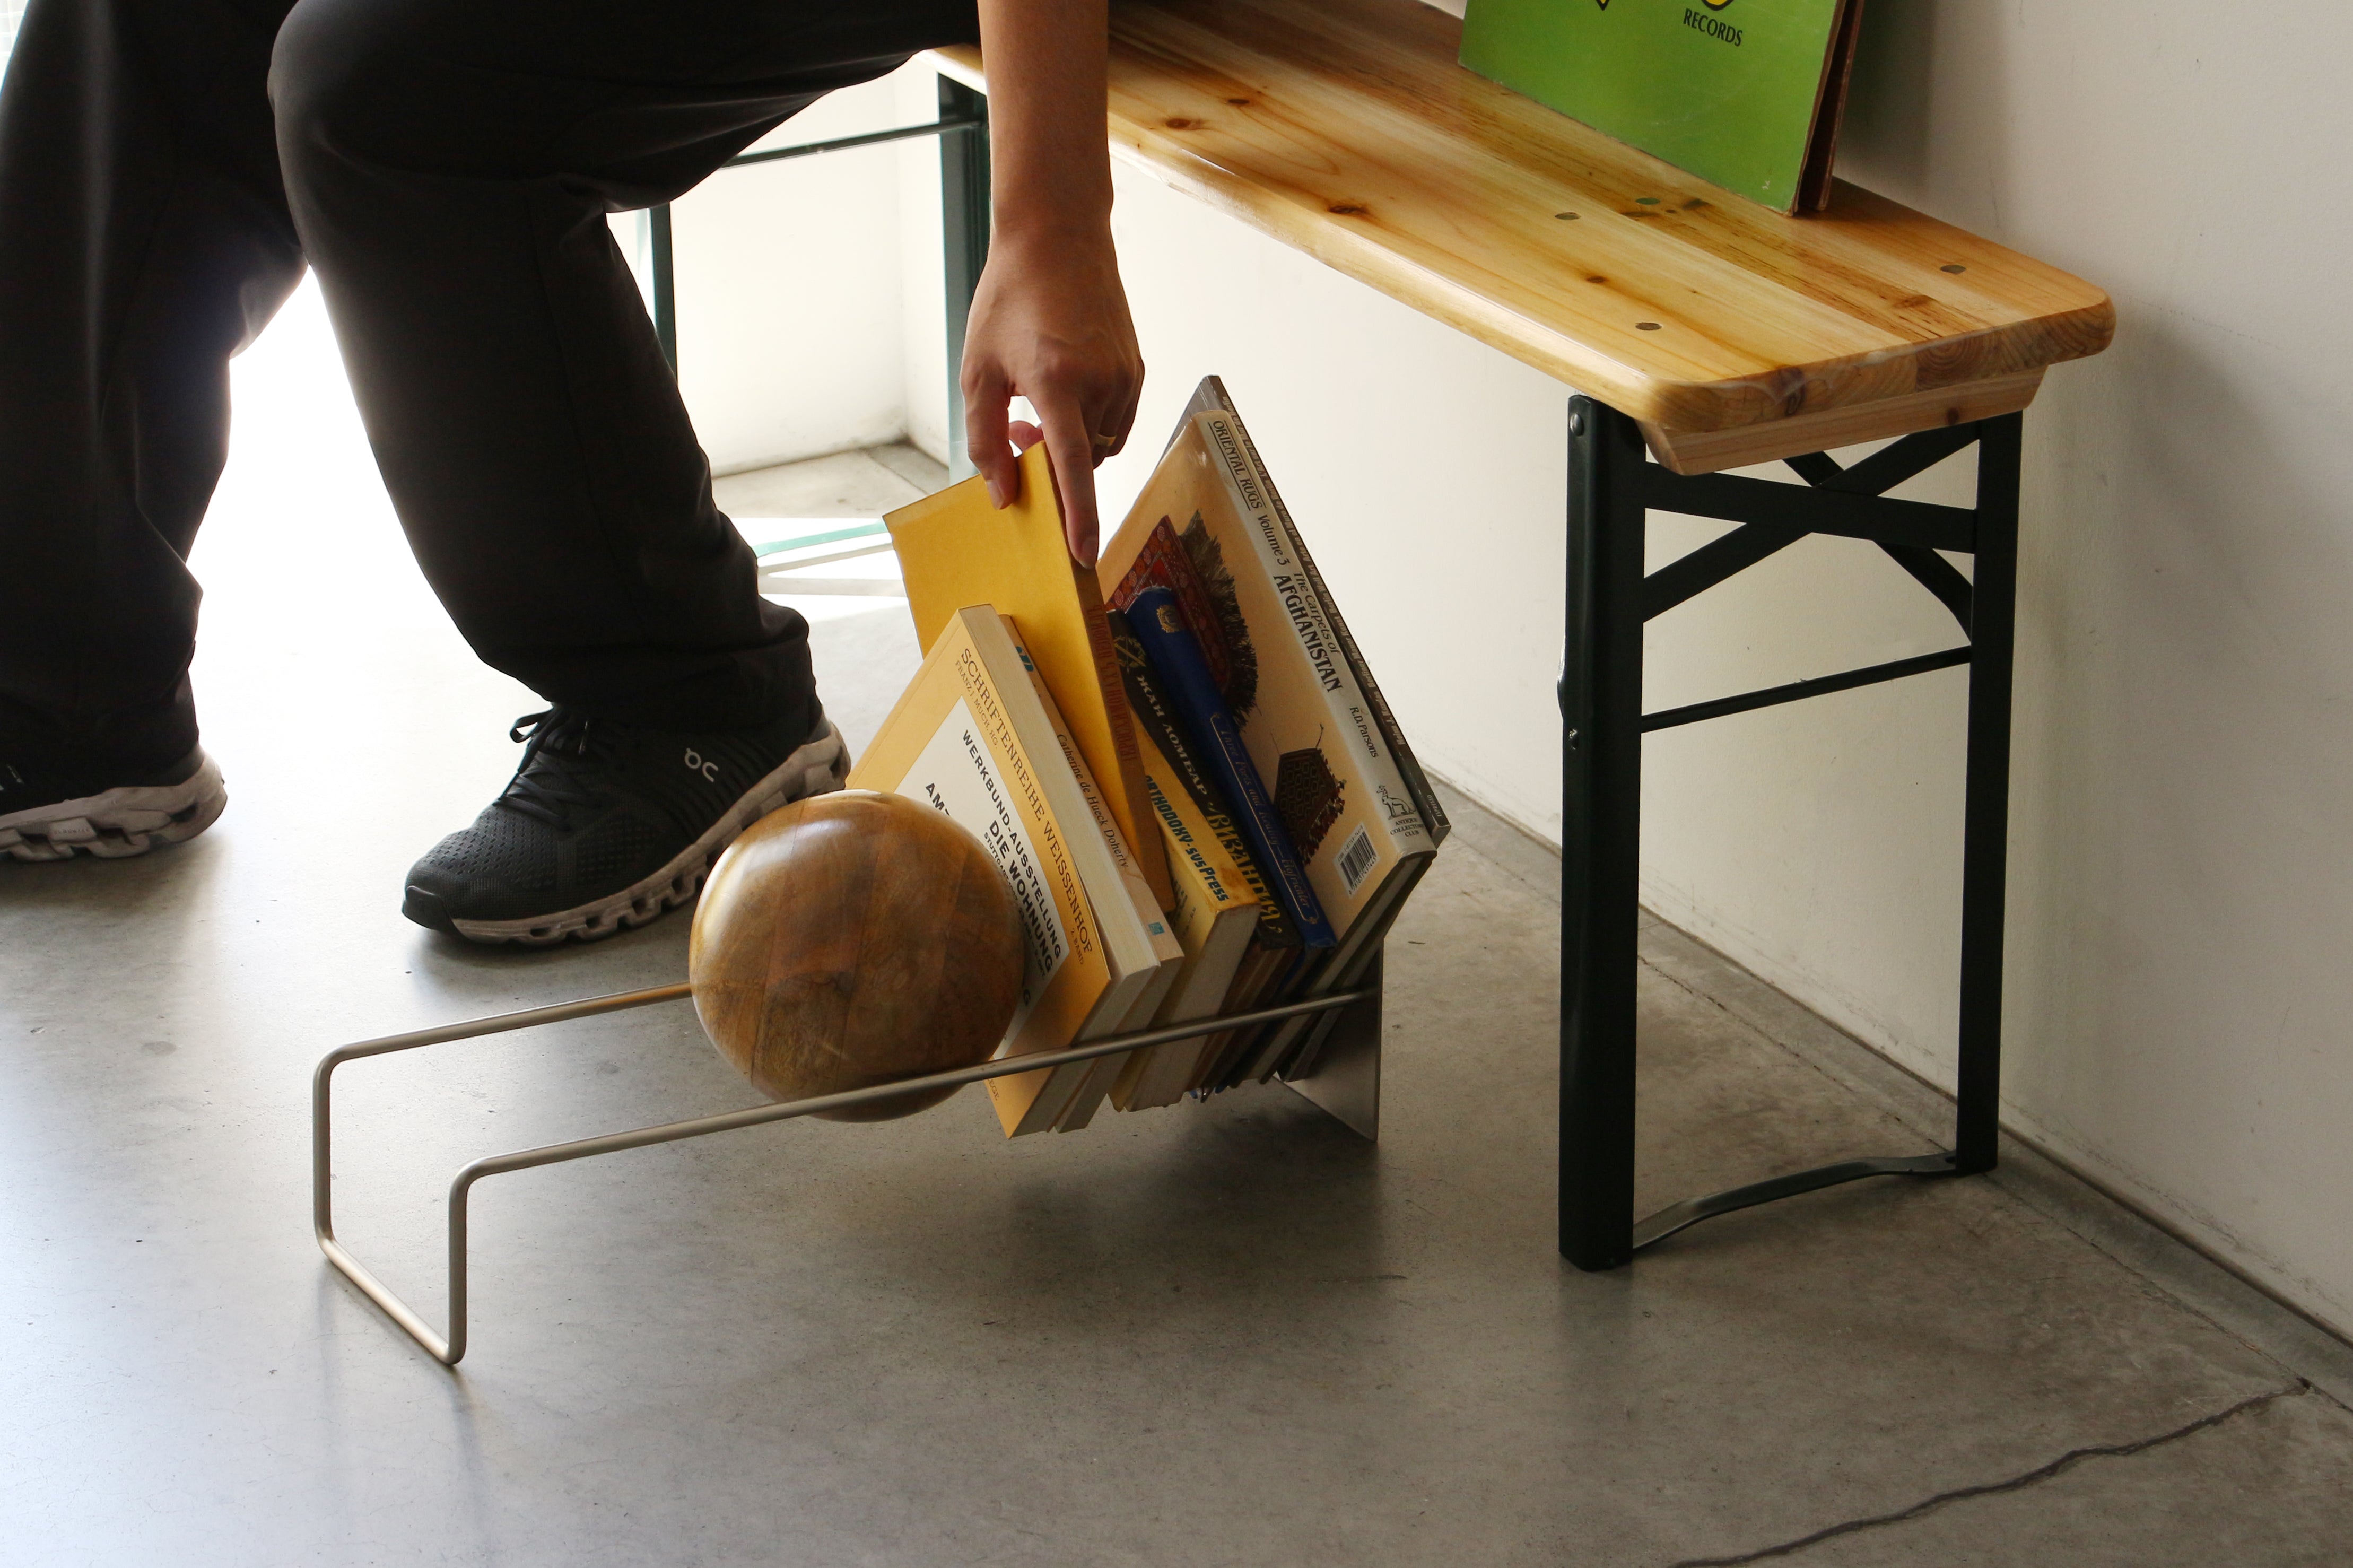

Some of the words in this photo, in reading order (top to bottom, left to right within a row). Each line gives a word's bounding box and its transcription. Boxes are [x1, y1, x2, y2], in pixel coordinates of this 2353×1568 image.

[1683, 8, 1743, 47] RECORDS
[1213, 420, 1246, 475] ORIENTAL
[1240, 479, 1263, 509] RUGS
[1257, 515, 1283, 556] Volume
[1307, 564, 1319, 577] Art
[1312, 576, 1327, 591] Wall
[1294, 571, 1309, 592] The
[1305, 595, 1332, 640] Carpets
[1328, 642, 1340, 654] of
[1322, 593, 1338, 613] Berlin
[1273, 575, 1343, 693] AFGHANISTAN
[1334, 616, 1349, 636] Kunst
[1345, 637, 1361, 659] Mauer
[955, 660, 972, 691] FRANZ
[1357, 659, 1376, 687] Berliner
[1358, 722, 1379, 758] Parsons
[1221, 730, 1239, 757] Three
[1235, 761, 1252, 786] Poets
[1249, 788, 1266, 806] and
[961, 648, 1044, 822] SCHRIFTENREIHE
[1044, 821, 1093, 953] WEISSENHOF
[1057, 734, 1083, 779] Catherine
[1080, 781, 1090, 793] de
[1087, 796, 1108, 826] Hueck
[1104, 829, 1129, 868] Doherty
[1136, 675, 1165, 717] ЖАН
[1162, 723, 1208, 796] ЛОМБАР
[1208, 802, 1283, 934] ВИЗАНТИЯ
[963, 730, 1061, 959] WERKBUND-AUSSTELLUNG
[989, 820, 1009, 859] DIE
[1009, 860, 1053, 971] WOHNUNG
[1074, 938, 1084, 965] BAND
